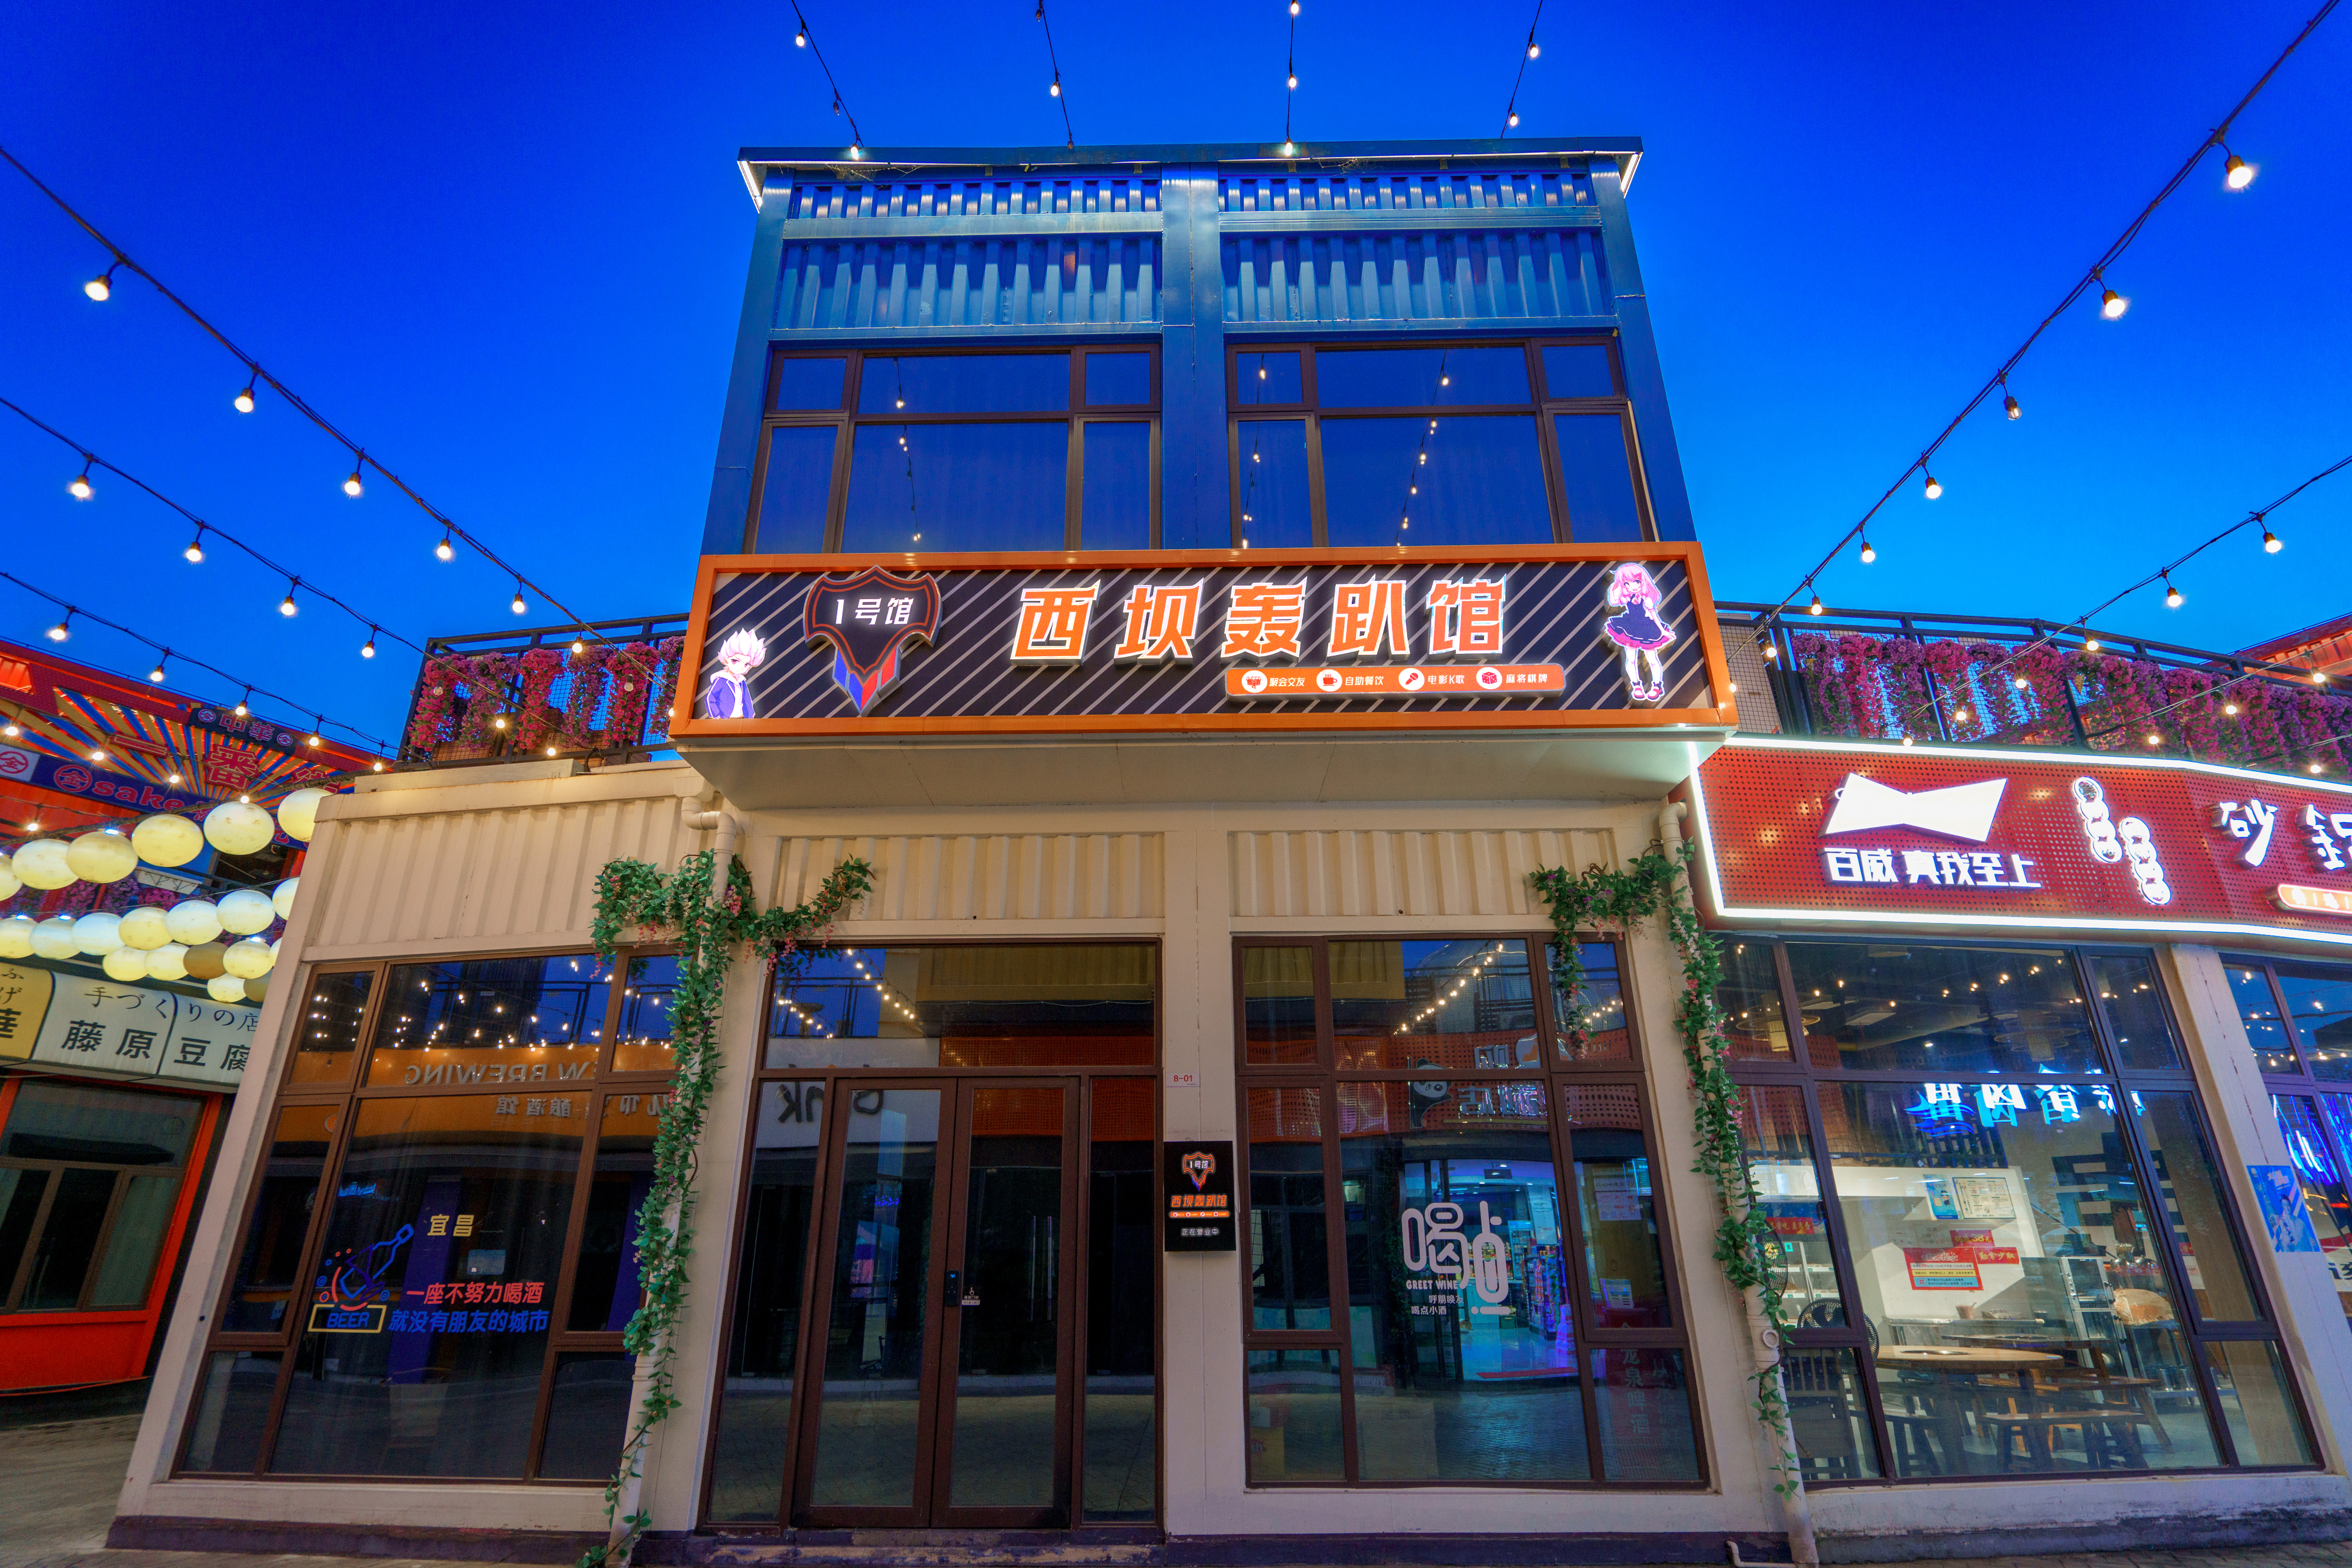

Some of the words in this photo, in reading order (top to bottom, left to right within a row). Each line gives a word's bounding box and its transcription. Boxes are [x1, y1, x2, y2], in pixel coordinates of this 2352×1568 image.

[835, 597, 914, 626] 1号馆
[1010, 573, 1507, 666] 西坝轰趴馆
[1269, 676, 1305, 688] 聚会交友
[1345, 676, 1384, 687] 自助餐饮
[1428, 674, 1465, 686] 电影K歌
[1506, 674, 1548, 685] 麻将棋牌
[92, 781, 184, 811] sake
[1824, 847, 1900, 884] 百威
[1905, 851, 2042, 890] 真我至上
[85, 987, 260, 1032] 手づくりの店
[1190, 1161, 1208, 1169] 1号馆
[1171, 1195, 1227, 1207] 西坝轰趴馆
[427, 1214, 474, 1236] 宜昌
[406, 1282, 544, 1305] 一座不努力喝酒
[1406, 1280, 1433, 1290] GREET
[1435, 1280, 1458, 1290] WINE
[1411, 1305, 1447, 1315] 喝点小酒
[1429, 1295, 1464, 1305] 呼朋唤友
[327, 1312, 369, 1329] BEER
[388, 1309, 550, 1333] 就没有朋友的城市
